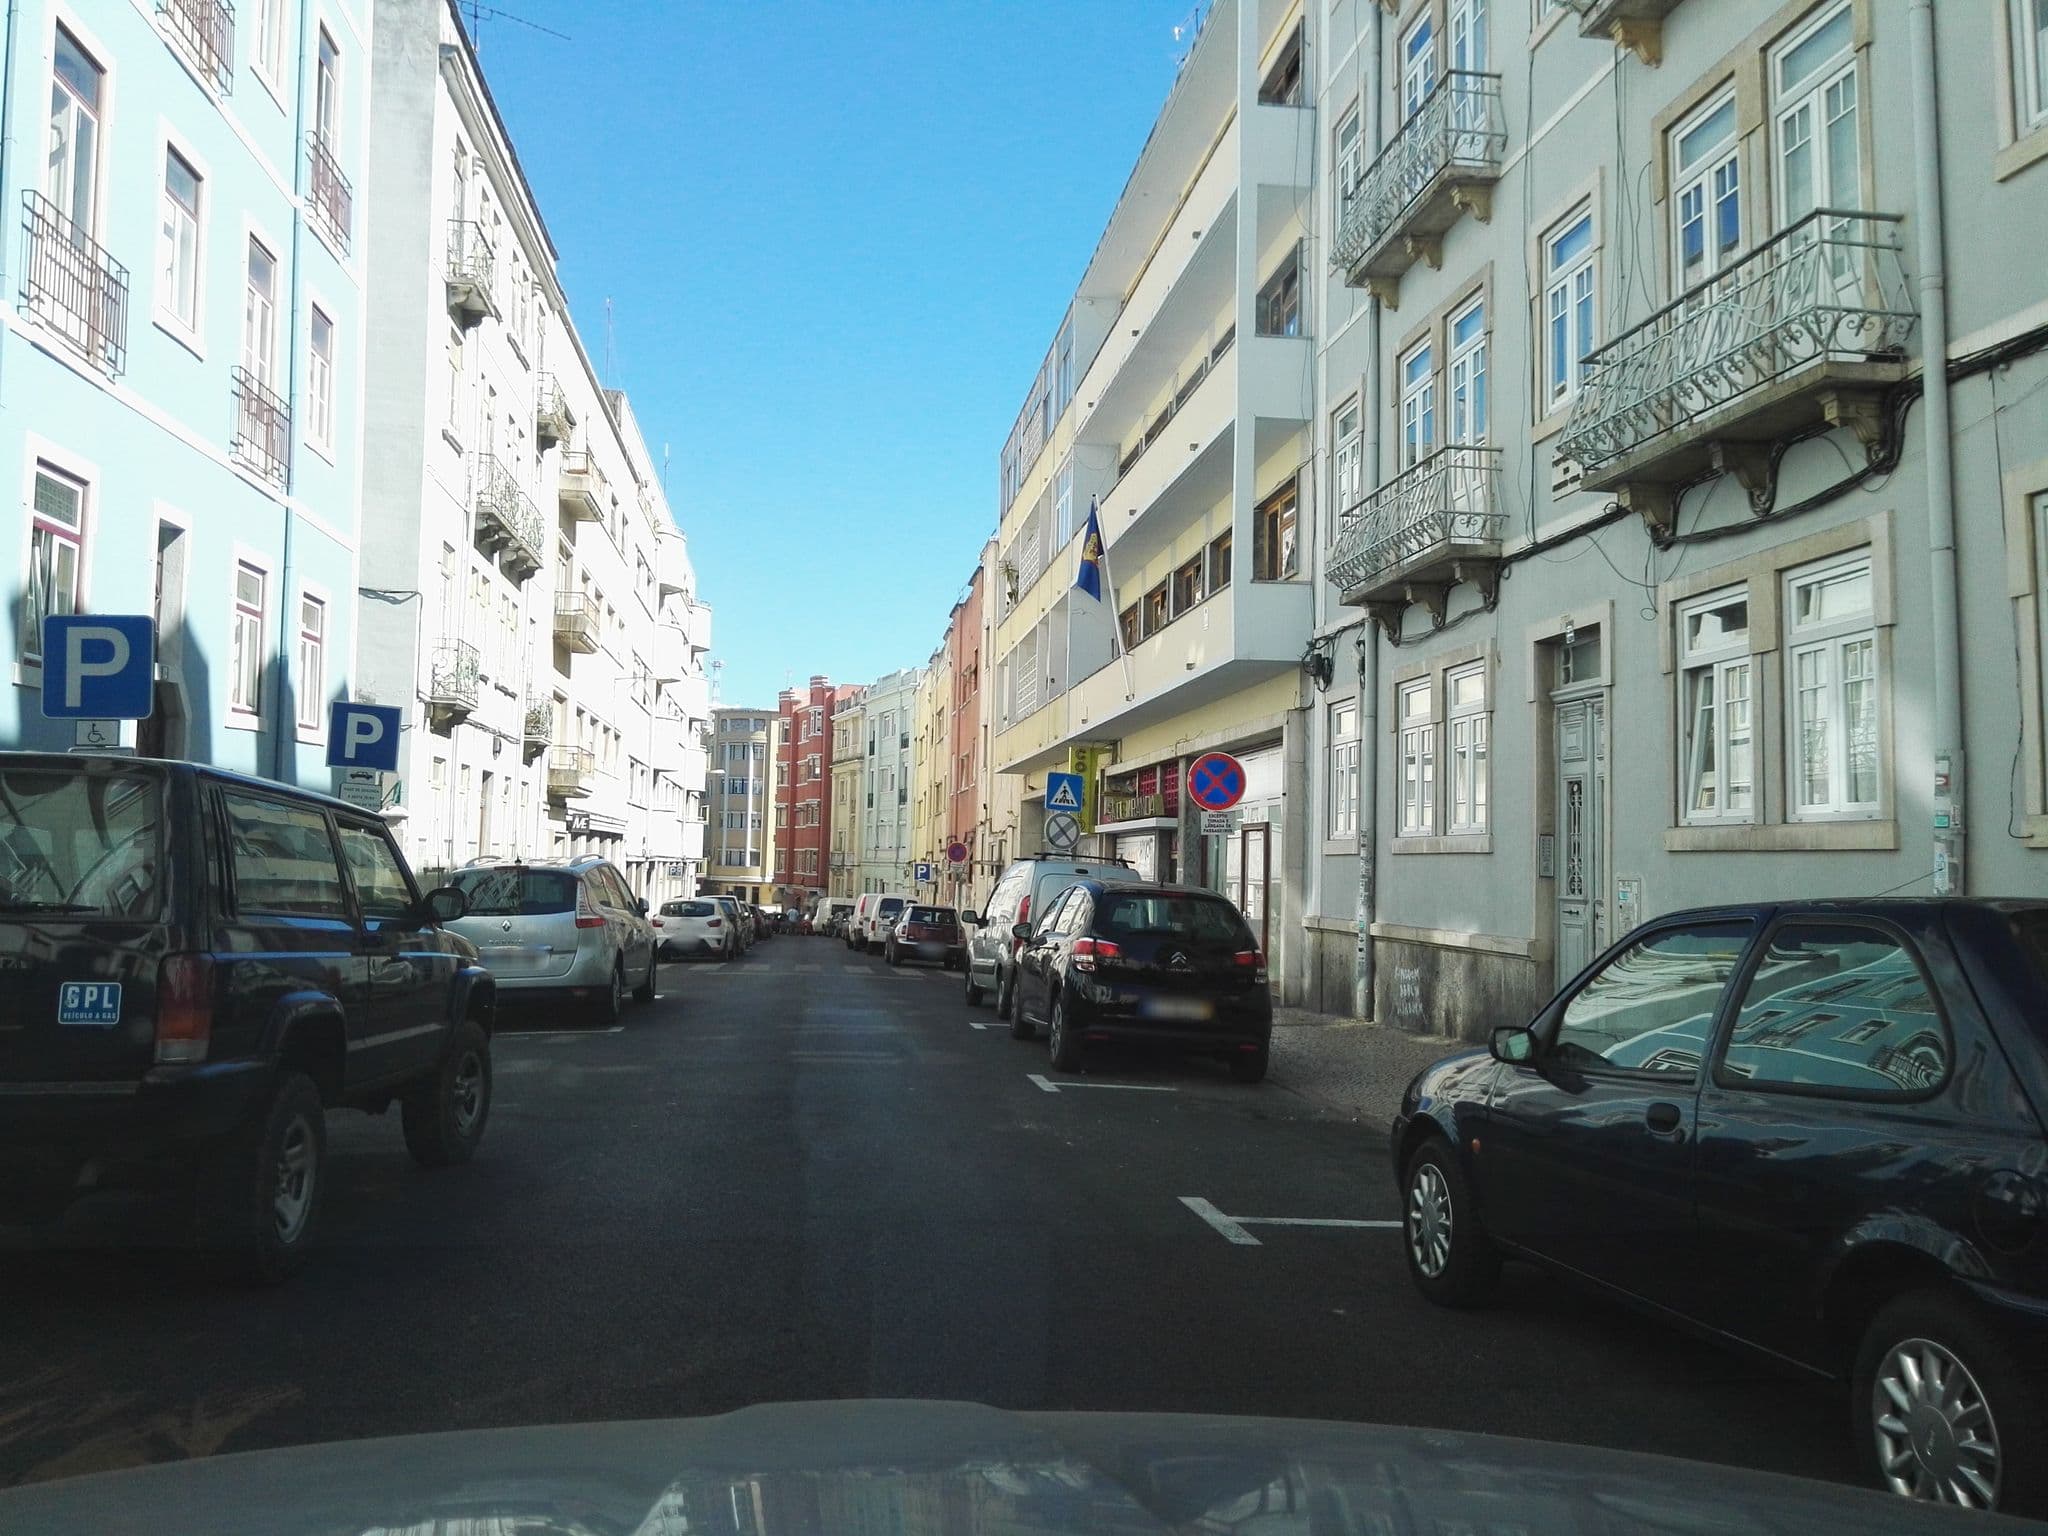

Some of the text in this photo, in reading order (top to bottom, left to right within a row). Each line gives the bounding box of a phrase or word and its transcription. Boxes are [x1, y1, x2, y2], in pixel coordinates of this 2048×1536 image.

[65, 626, 131, 708] P
[344, 711, 385, 759] P
[917, 865, 927, 878] P
[67, 987, 113, 1008] GPL
